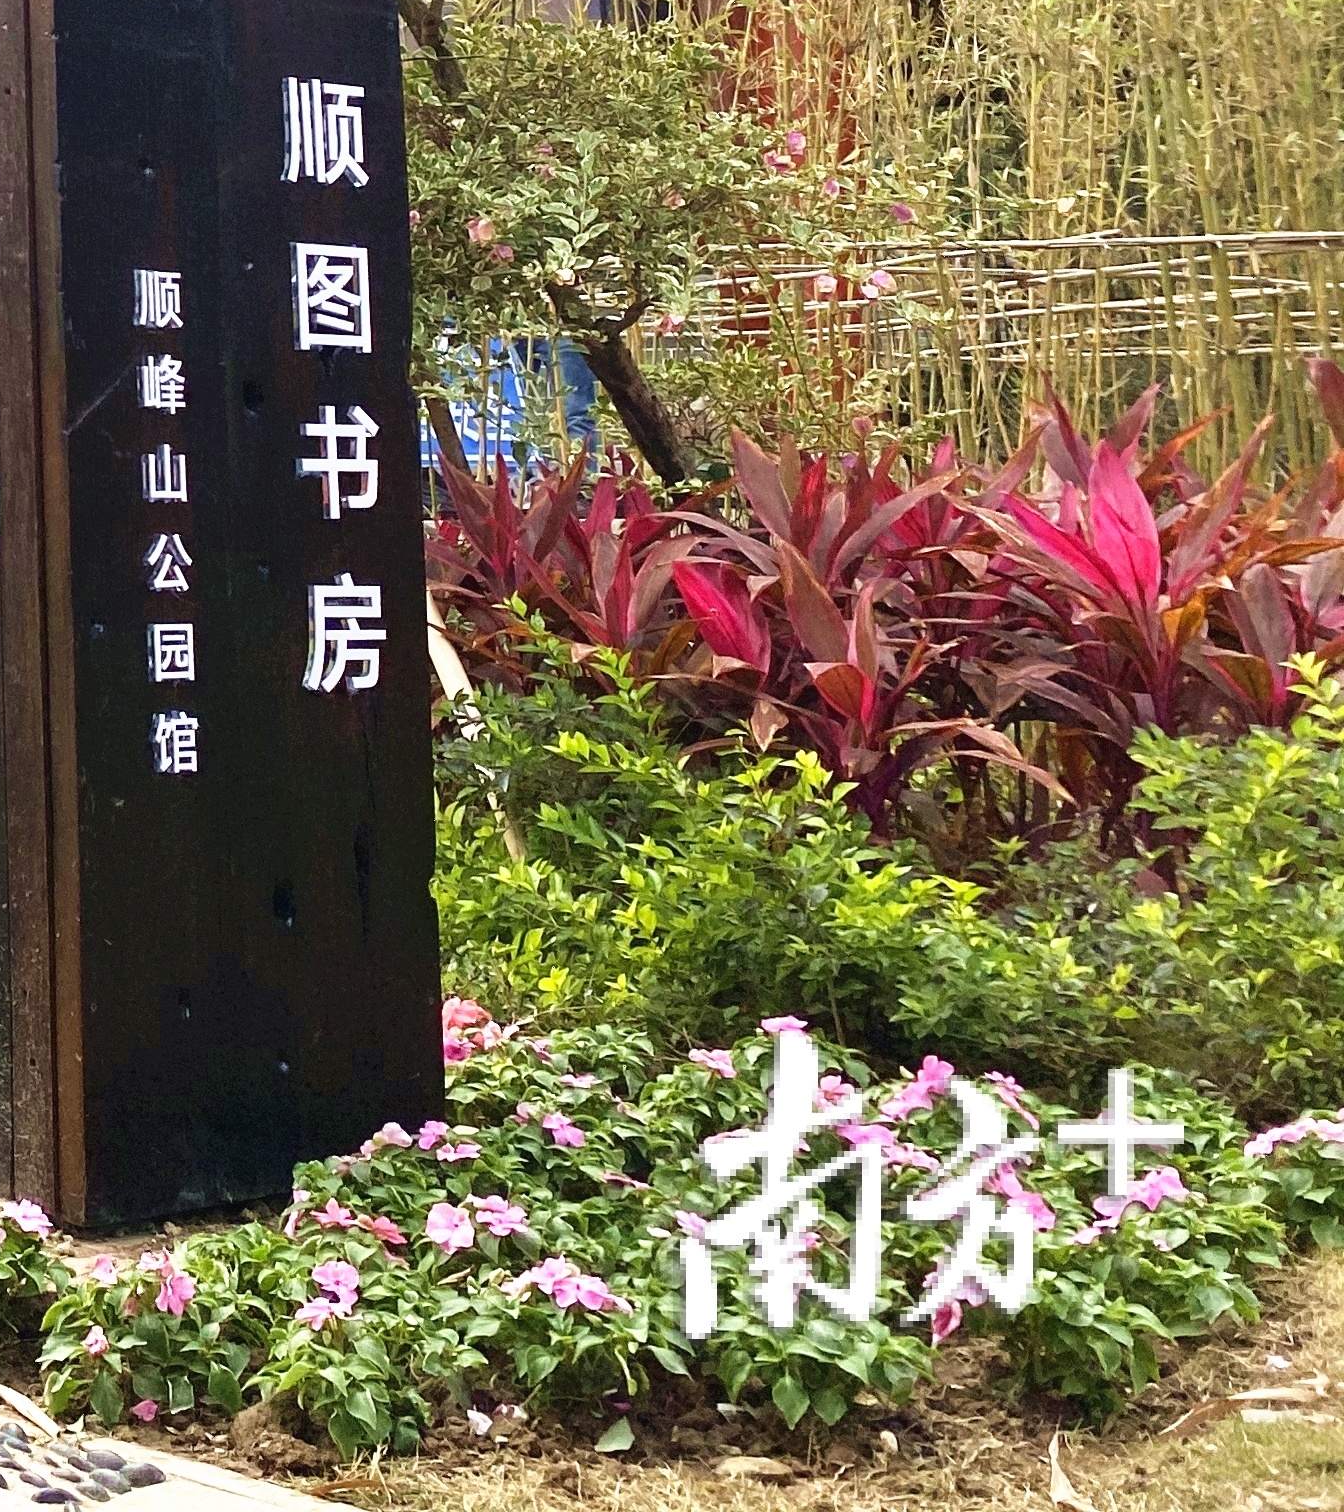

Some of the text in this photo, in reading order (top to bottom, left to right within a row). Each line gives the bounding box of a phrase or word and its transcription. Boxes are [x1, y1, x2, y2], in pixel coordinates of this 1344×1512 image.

[132, 268, 202, 775] 顺峰山公园馆
[279, 75, 388, 693] 顺图书房
